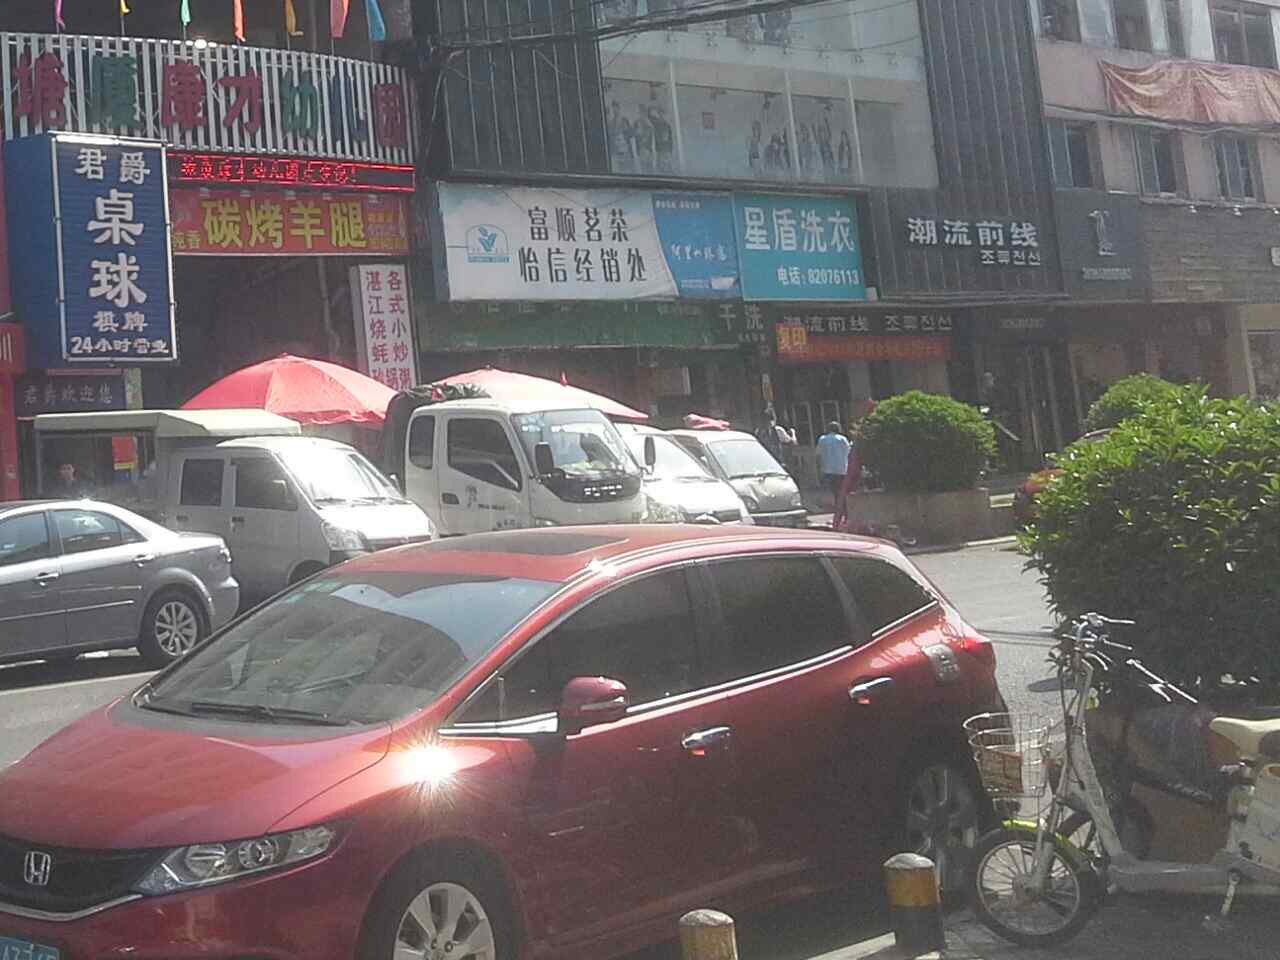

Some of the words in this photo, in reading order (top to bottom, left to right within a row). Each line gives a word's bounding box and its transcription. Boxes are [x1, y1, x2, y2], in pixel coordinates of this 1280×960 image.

[74, 147, 151, 185] 君爵
[200, 197, 368, 251] 碳烤羊腿
[527, 205, 632, 244] 富顺茗茶
[743, 204, 856, 255] 星盾洗衣
[907, 216, 1040, 249] 潮流前线
[86, 188, 148, 309] 桌球
[518, 245, 648, 285] 怡信经销处
[92, 310, 150, 333] 棋牌
[387, 270, 410, 363] 各式小炒
